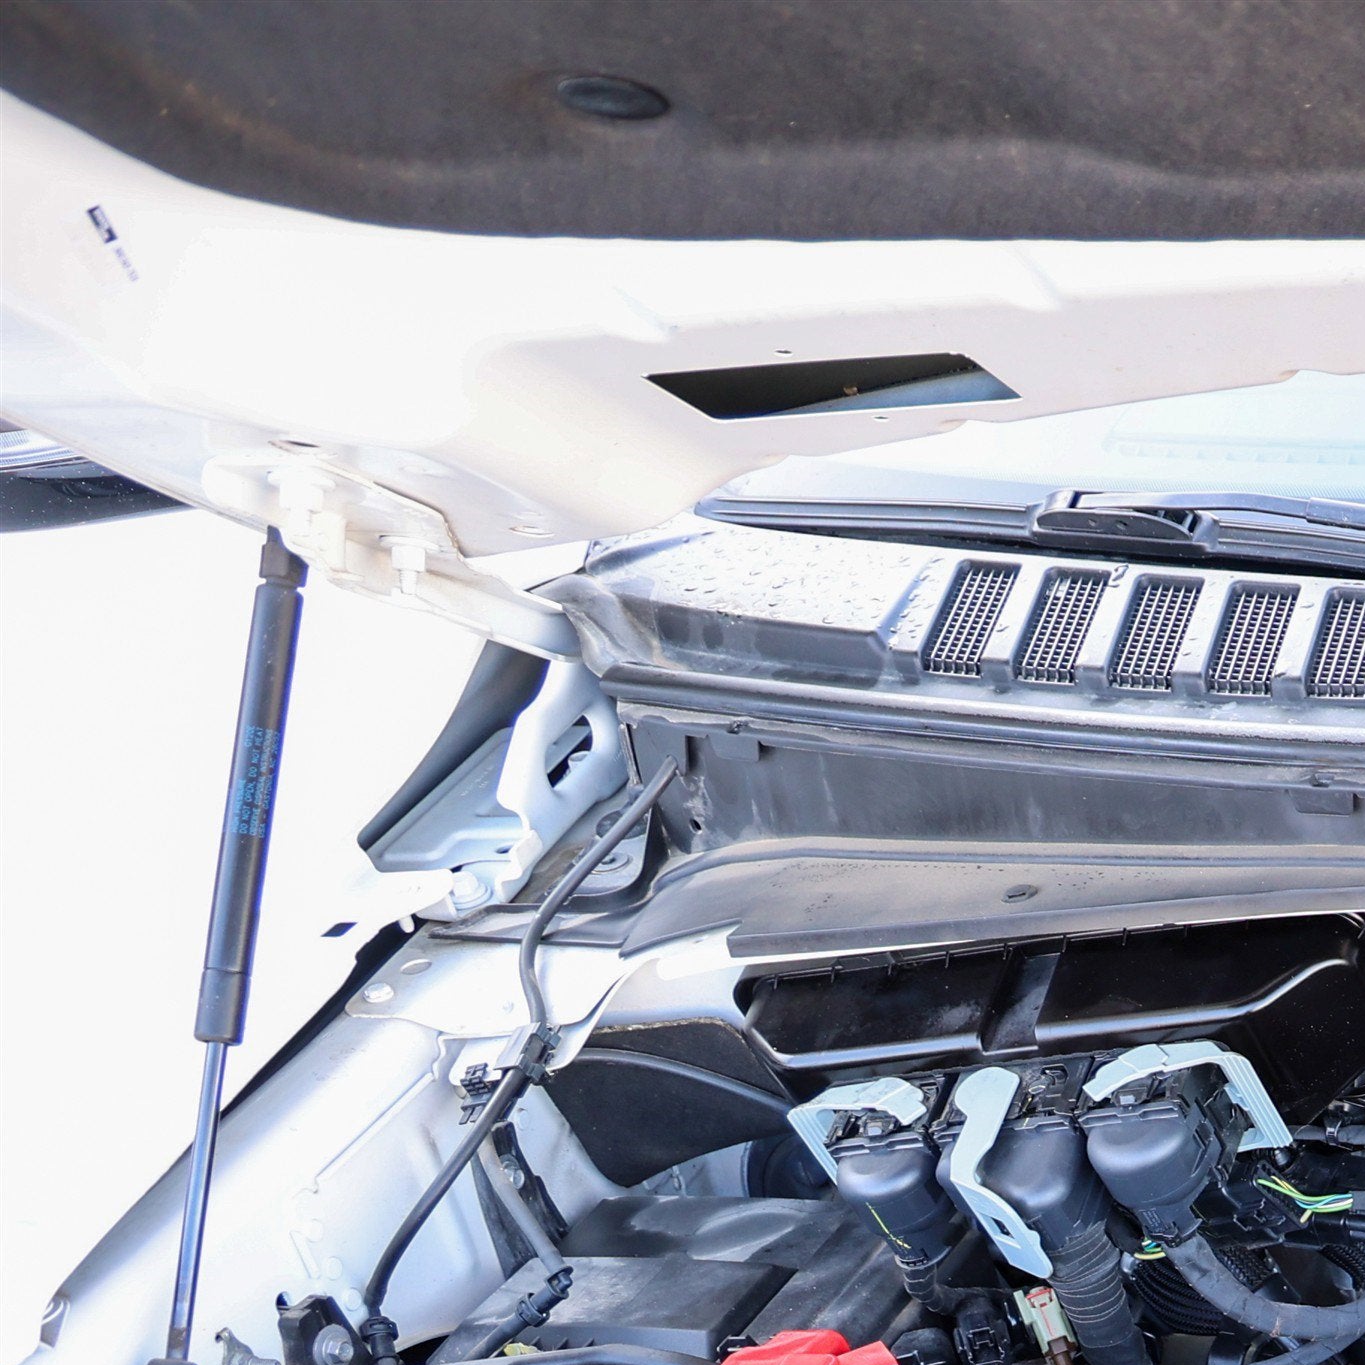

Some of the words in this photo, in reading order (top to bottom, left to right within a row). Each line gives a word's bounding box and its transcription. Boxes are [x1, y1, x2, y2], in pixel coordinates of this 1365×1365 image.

[253, 727, 262, 745] HEAT
[251, 748, 259, 763] NOT
[241, 805, 249, 820] NOT
